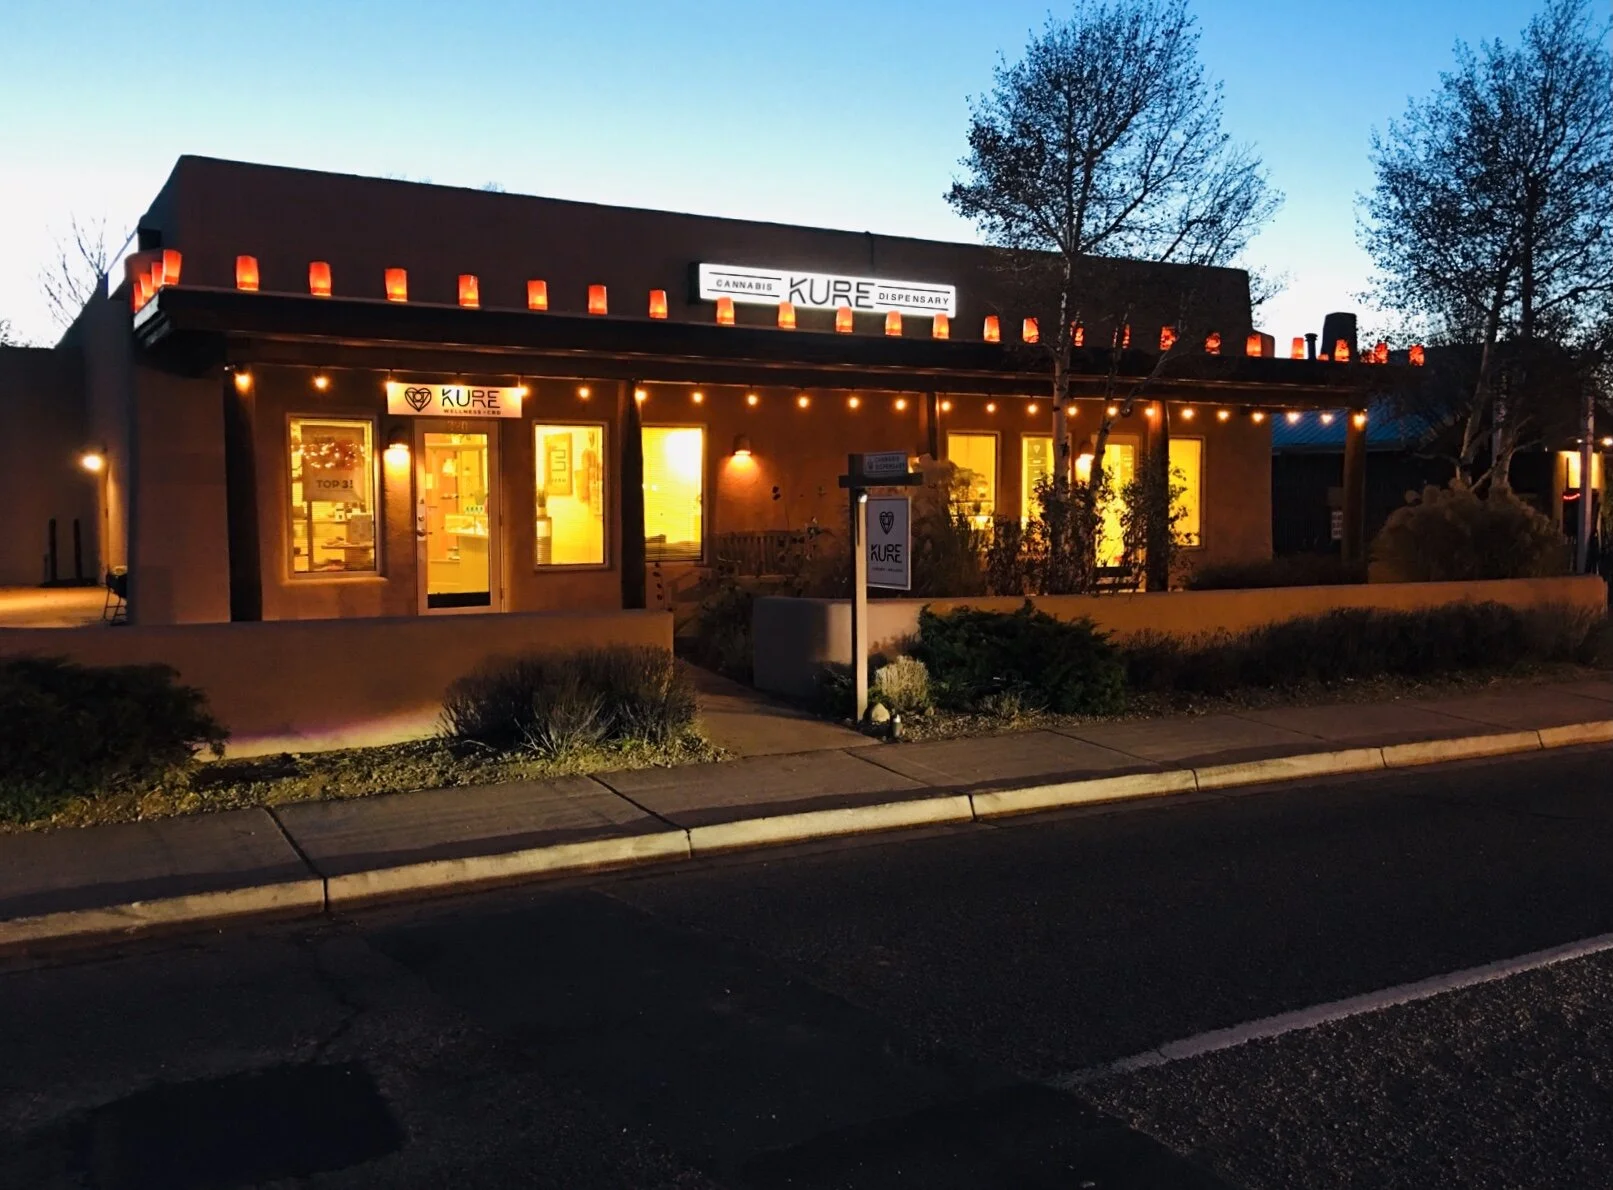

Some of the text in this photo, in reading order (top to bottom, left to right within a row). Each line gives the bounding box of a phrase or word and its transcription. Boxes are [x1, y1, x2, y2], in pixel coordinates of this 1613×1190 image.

[716, 277, 949, 309] CANNABIS KURE DISPENSARY
[441, 388, 501, 409] KURE
[316, 480, 339, 489] TOP
[870, 544, 903, 563] KURE
